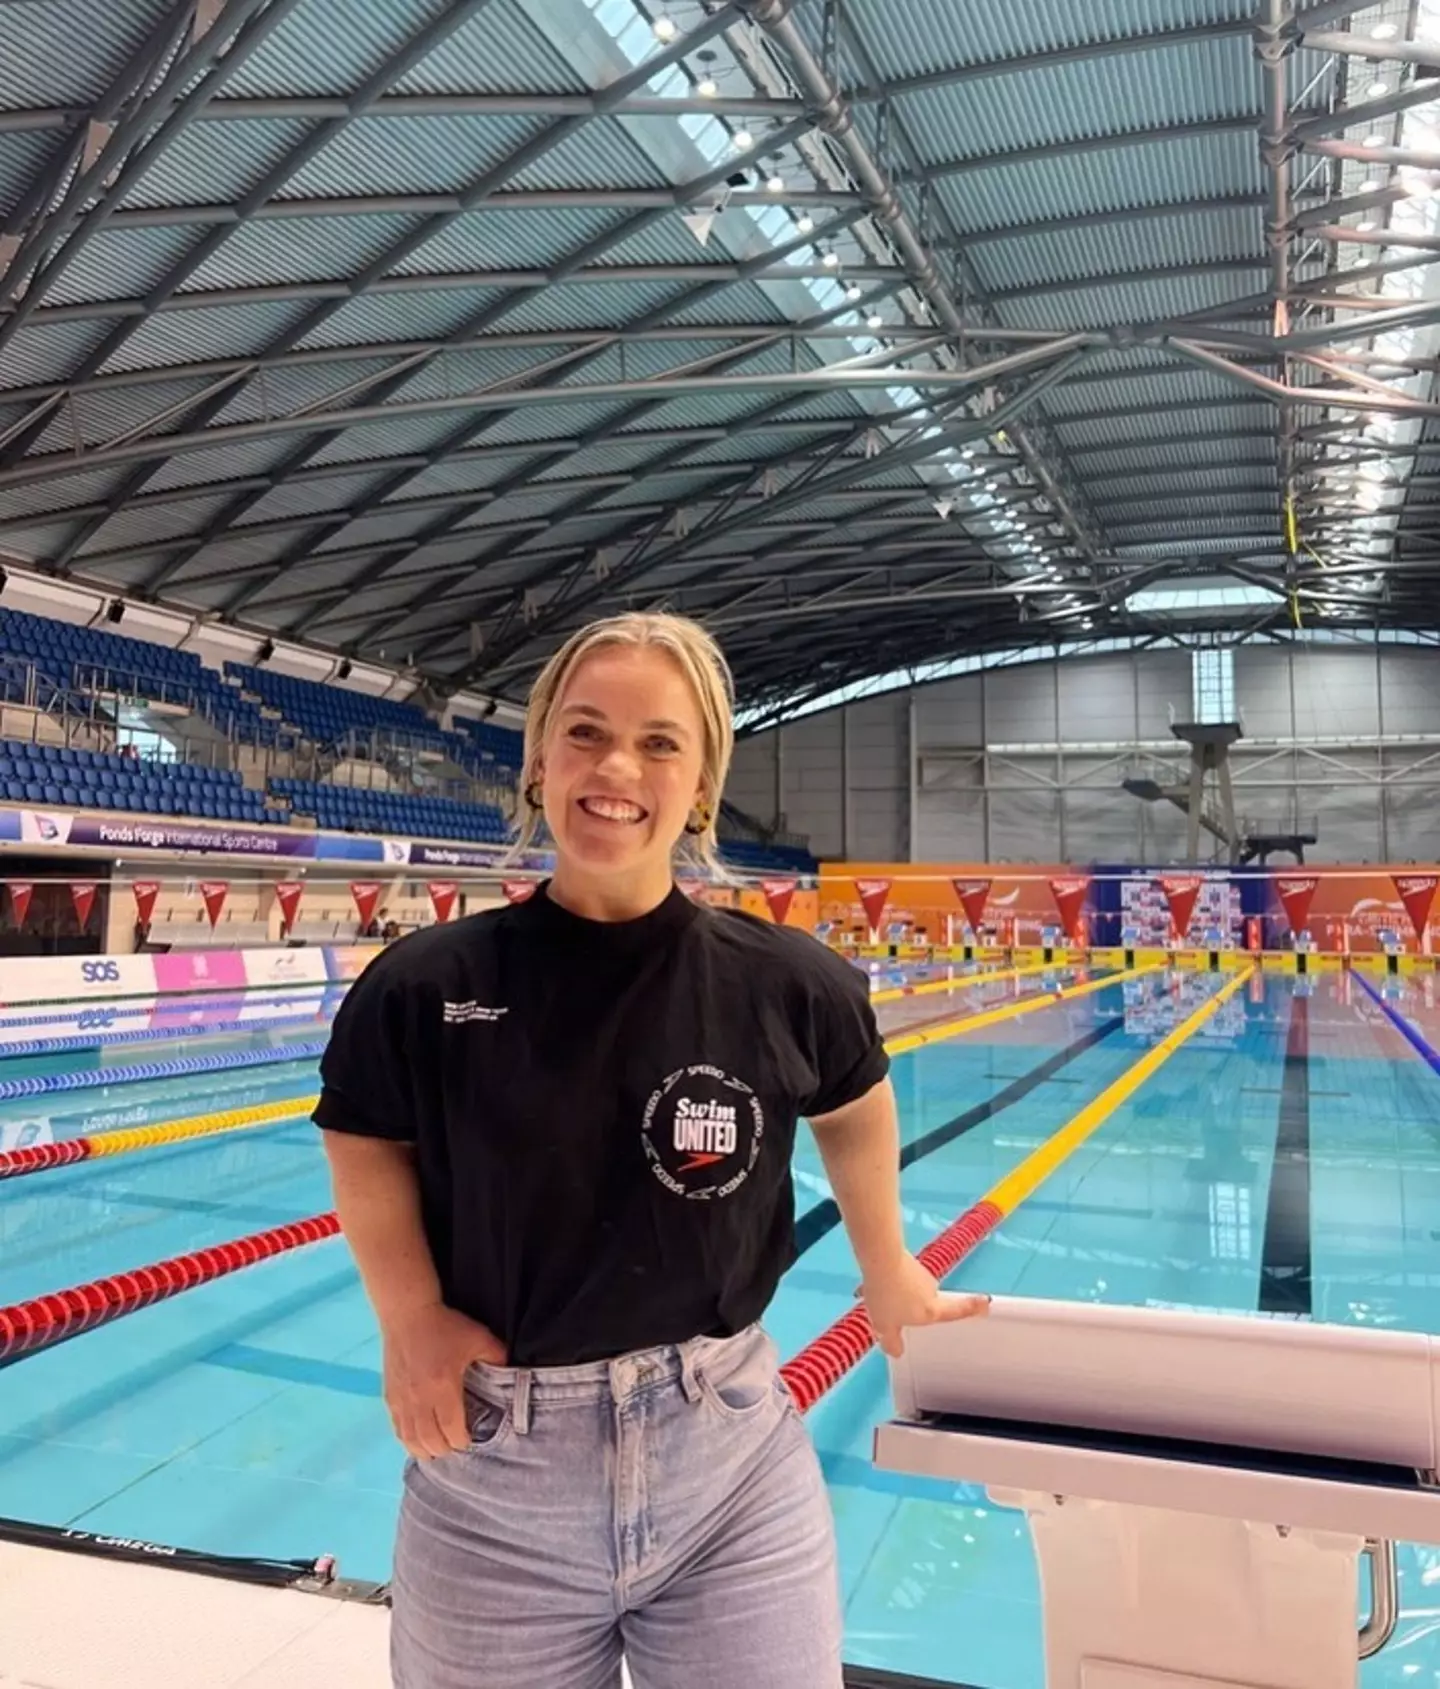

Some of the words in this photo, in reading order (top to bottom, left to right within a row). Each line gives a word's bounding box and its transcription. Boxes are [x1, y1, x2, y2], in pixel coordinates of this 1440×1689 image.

[99, 825, 133, 842] Ponds
[134, 825, 164, 847] Forge
[166, 828, 221, 847] International
[221, 832, 250, 851] Sports
[250, 836, 278, 851] Centre
[81, 961, 119, 982] SOS
[687, 1064, 725, 1080] SPEEDO
[675, 1097, 737, 1121] Swim
[674, 1118, 738, 1154] UNITED
